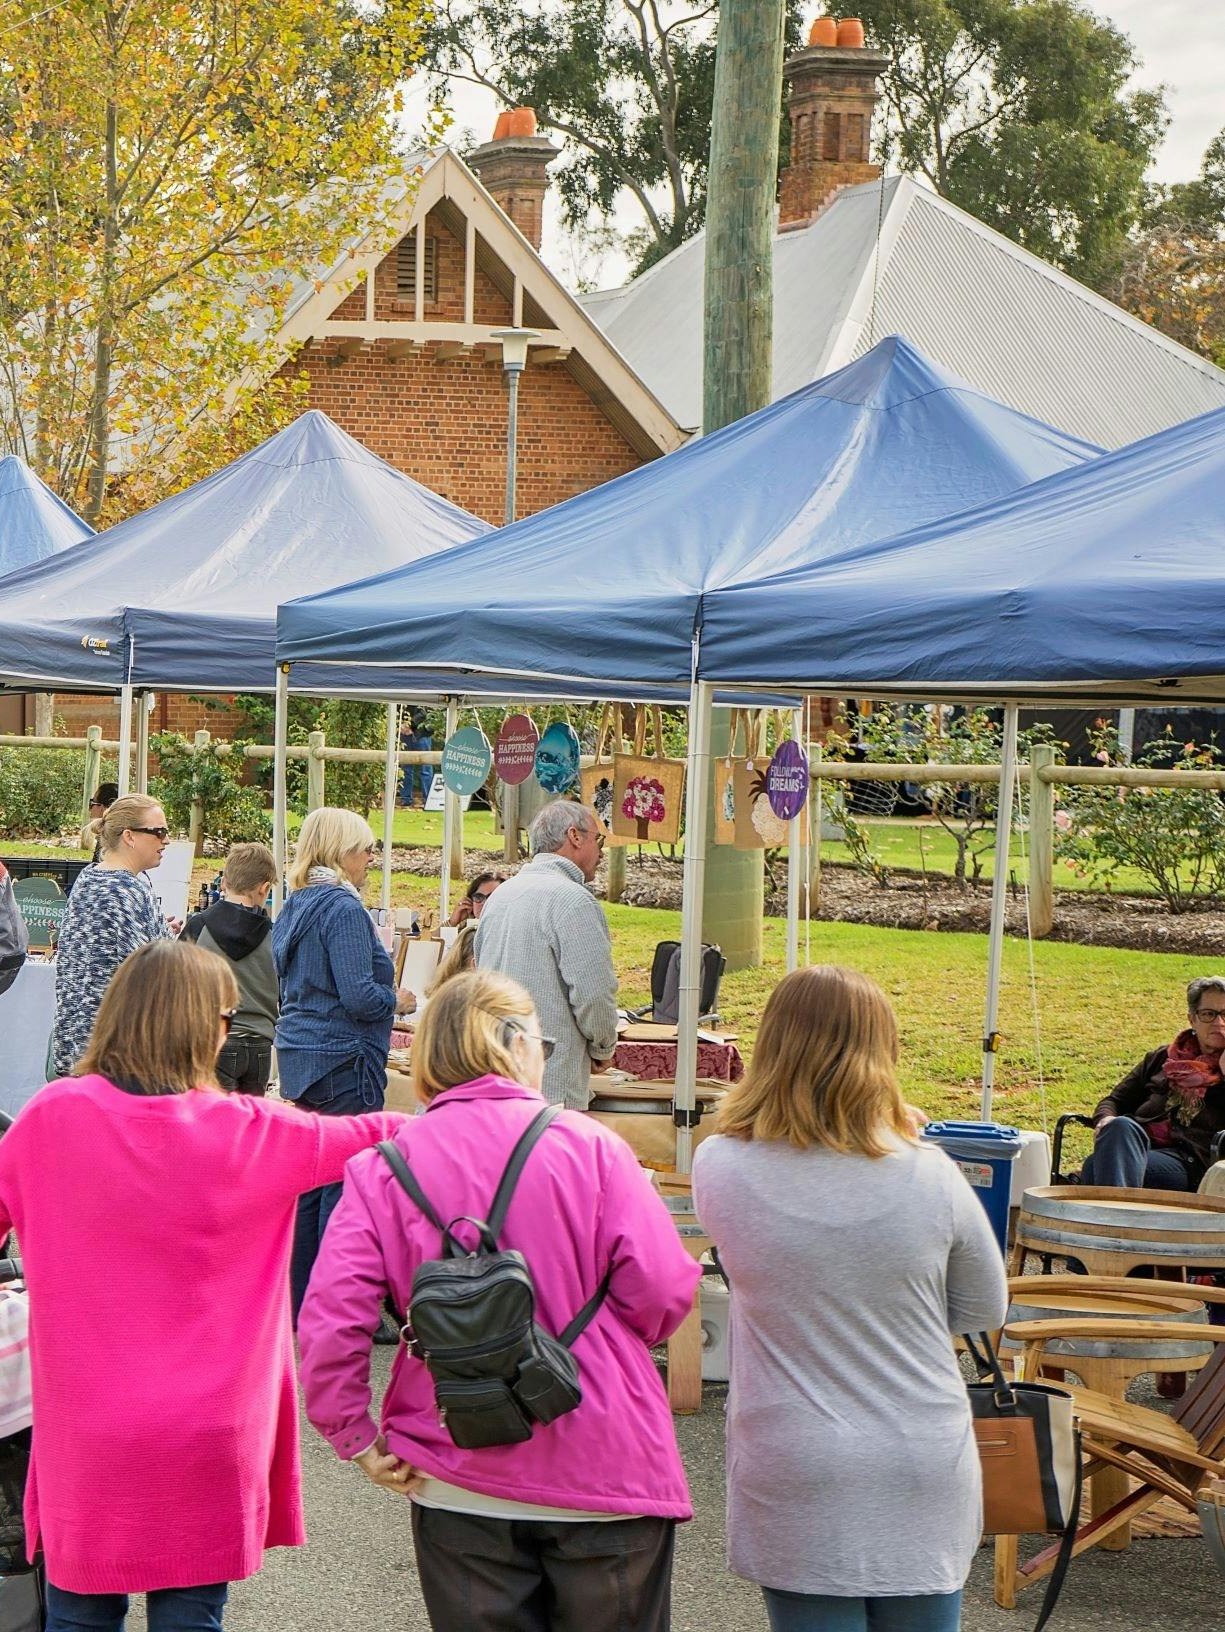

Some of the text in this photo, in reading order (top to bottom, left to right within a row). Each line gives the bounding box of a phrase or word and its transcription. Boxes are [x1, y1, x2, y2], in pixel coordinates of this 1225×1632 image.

[498, 743, 535, 754] HAPPINESS
[446, 750, 486, 768] HAPPINESS
[770, 778, 799, 792] DREAMS
[23, 893, 55, 904] choose
[20, 904, 65, 917] PPINESS
